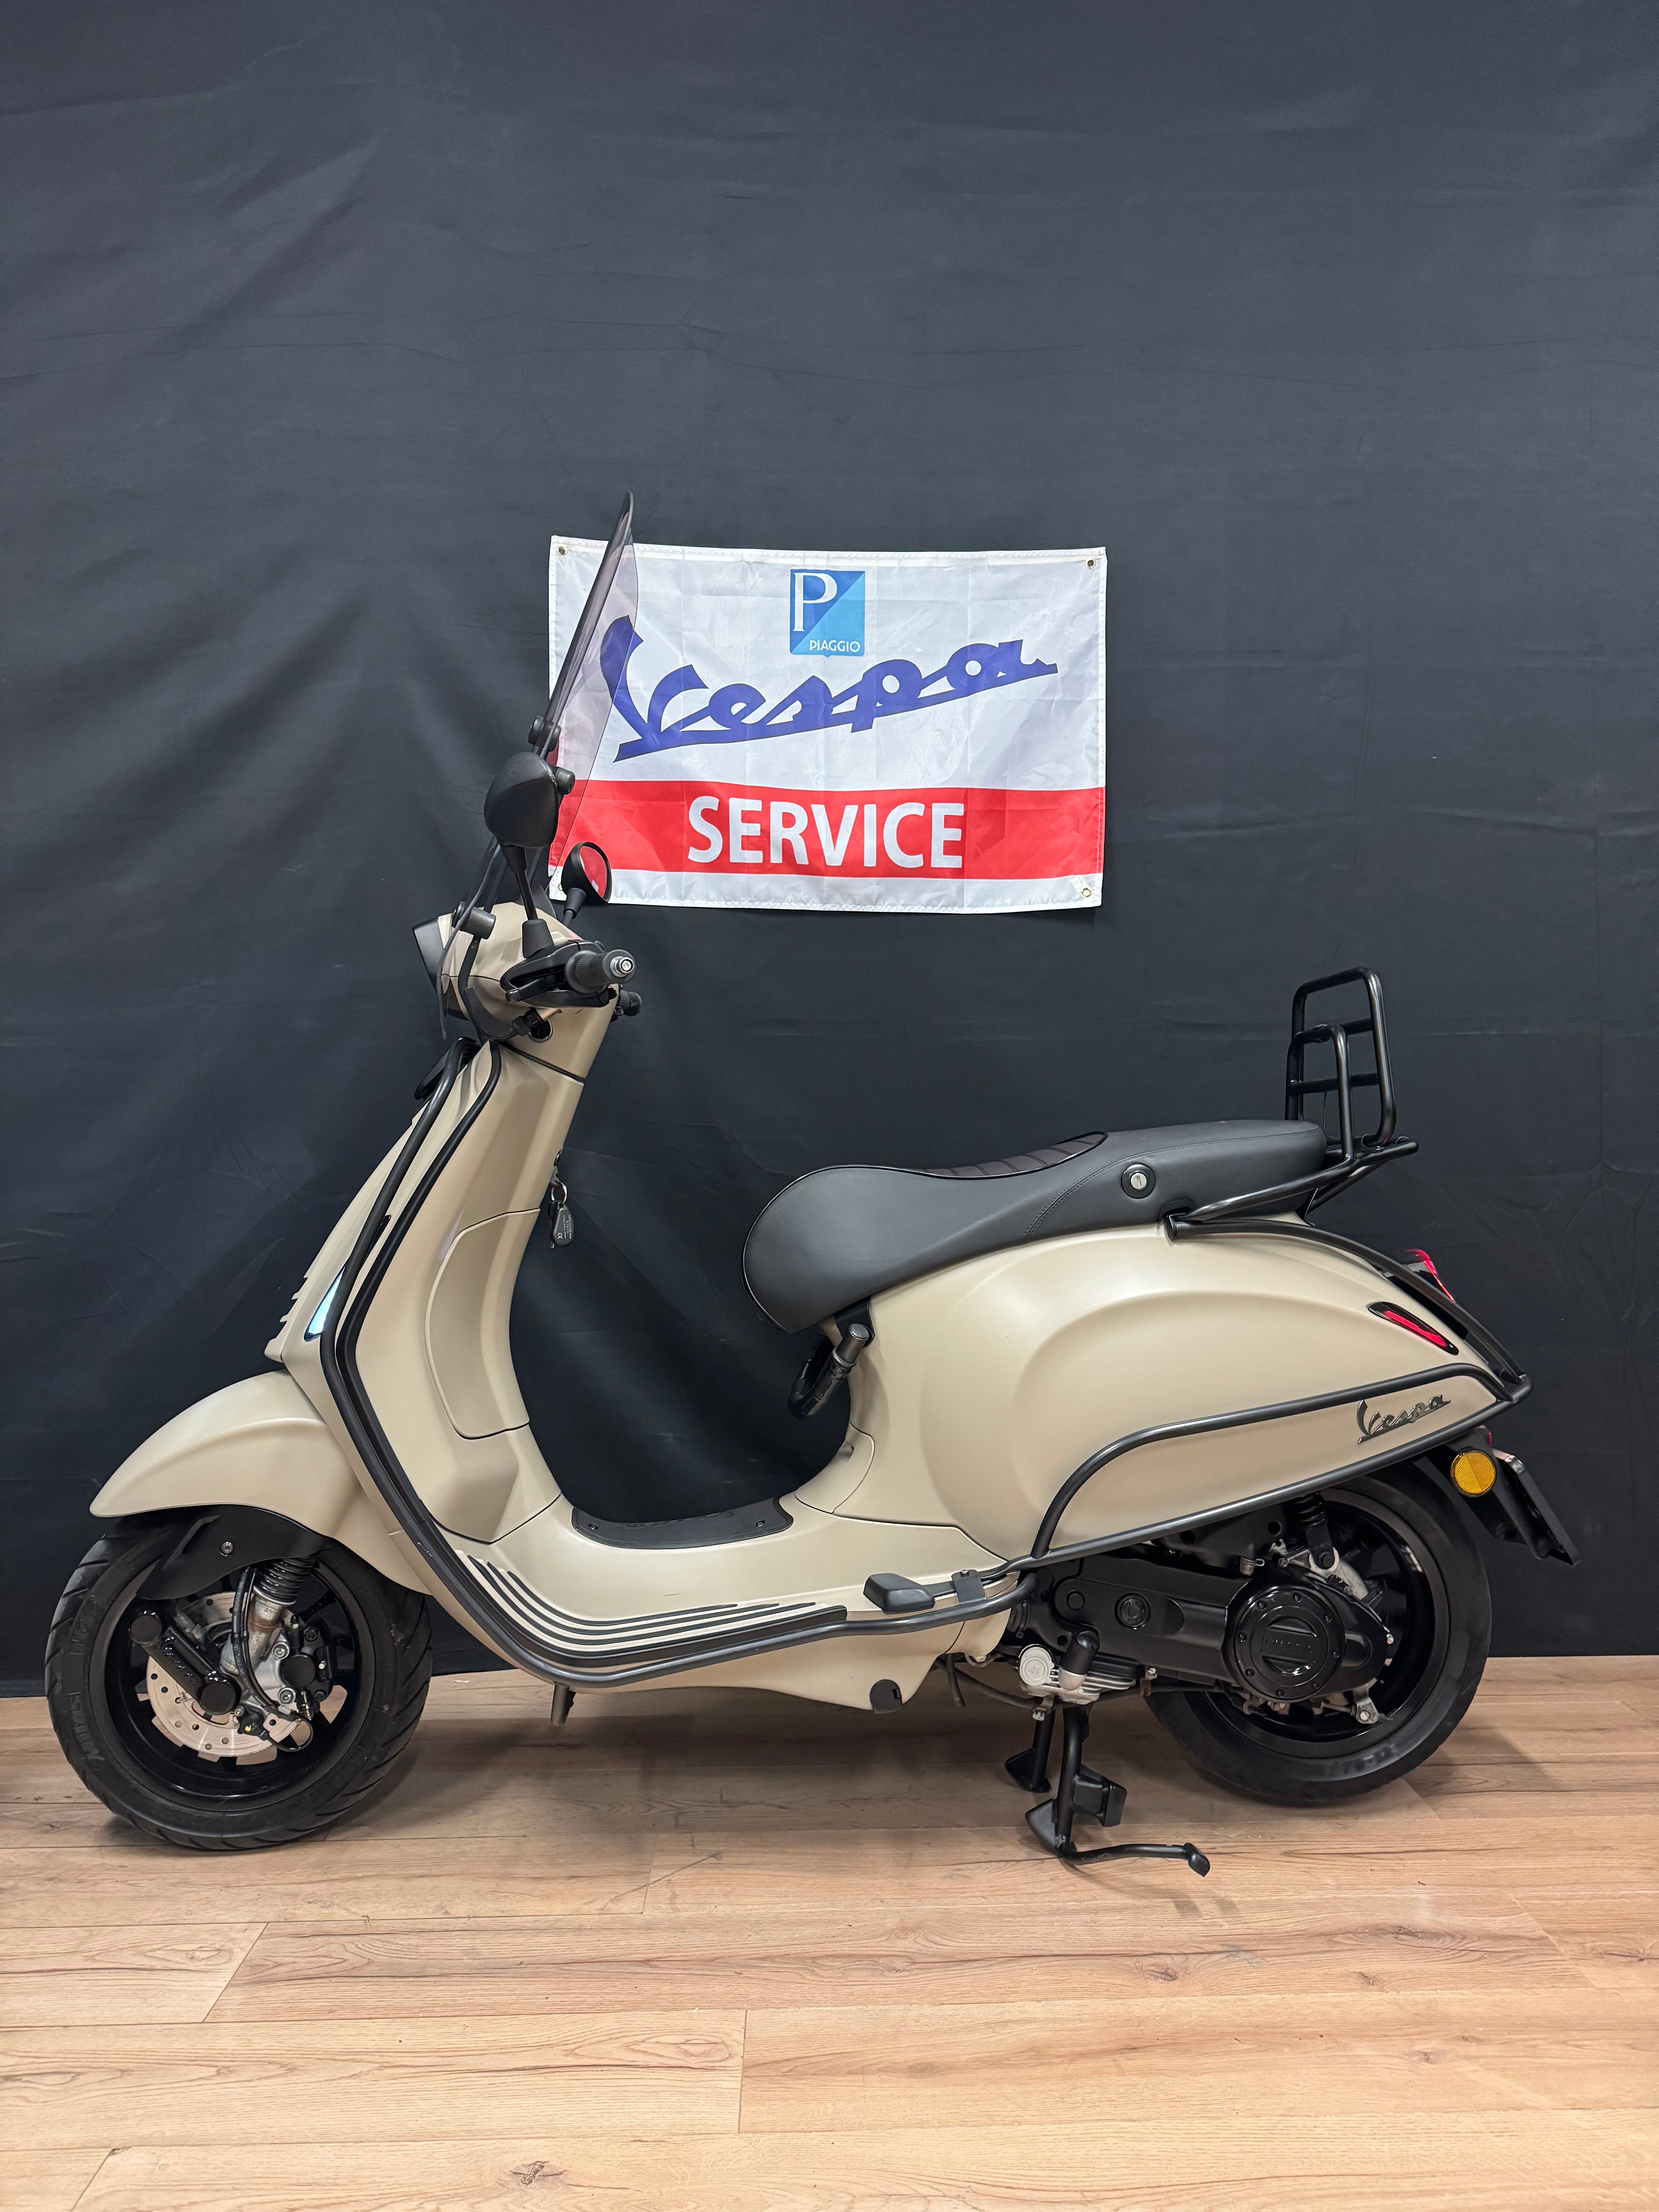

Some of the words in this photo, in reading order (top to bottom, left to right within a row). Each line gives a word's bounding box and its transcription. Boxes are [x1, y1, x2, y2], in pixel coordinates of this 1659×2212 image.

[793, 572, 837, 632] P
[809, 639, 860, 653] PIAGGIO
[600, 615, 1058, 762] Vespa
[687, 796, 965, 869] SERVICE
[1357, 1395, 1450, 1444] Vespa
